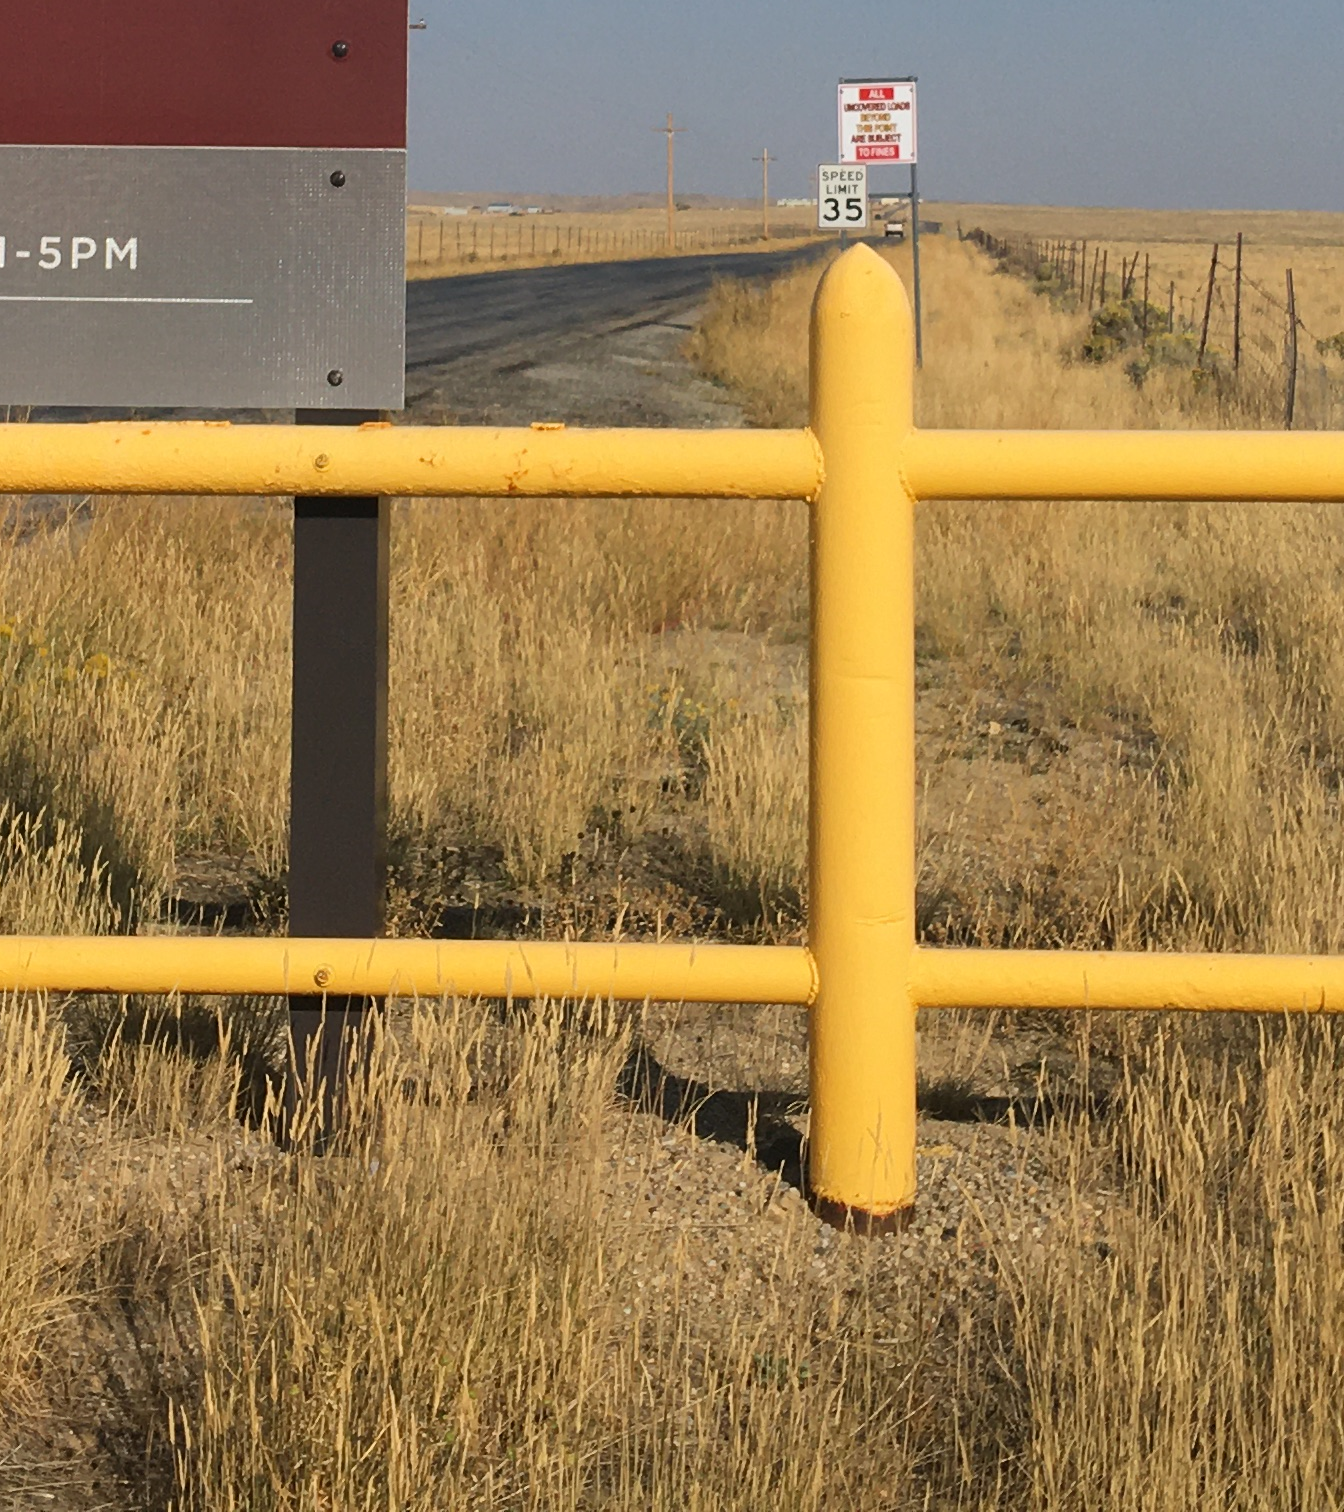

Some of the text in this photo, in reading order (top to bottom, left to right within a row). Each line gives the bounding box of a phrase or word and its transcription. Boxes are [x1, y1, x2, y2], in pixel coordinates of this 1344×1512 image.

[868, 90, 885, 99] ALL
[851, 134, 902, 143] ARE SUBJECT
[858, 147, 896, 157] TO FINES
[822, 171, 863, 181] SPEED
[826, 185, 858, 195] LIMIT
[823, 198, 863, 221] 35
